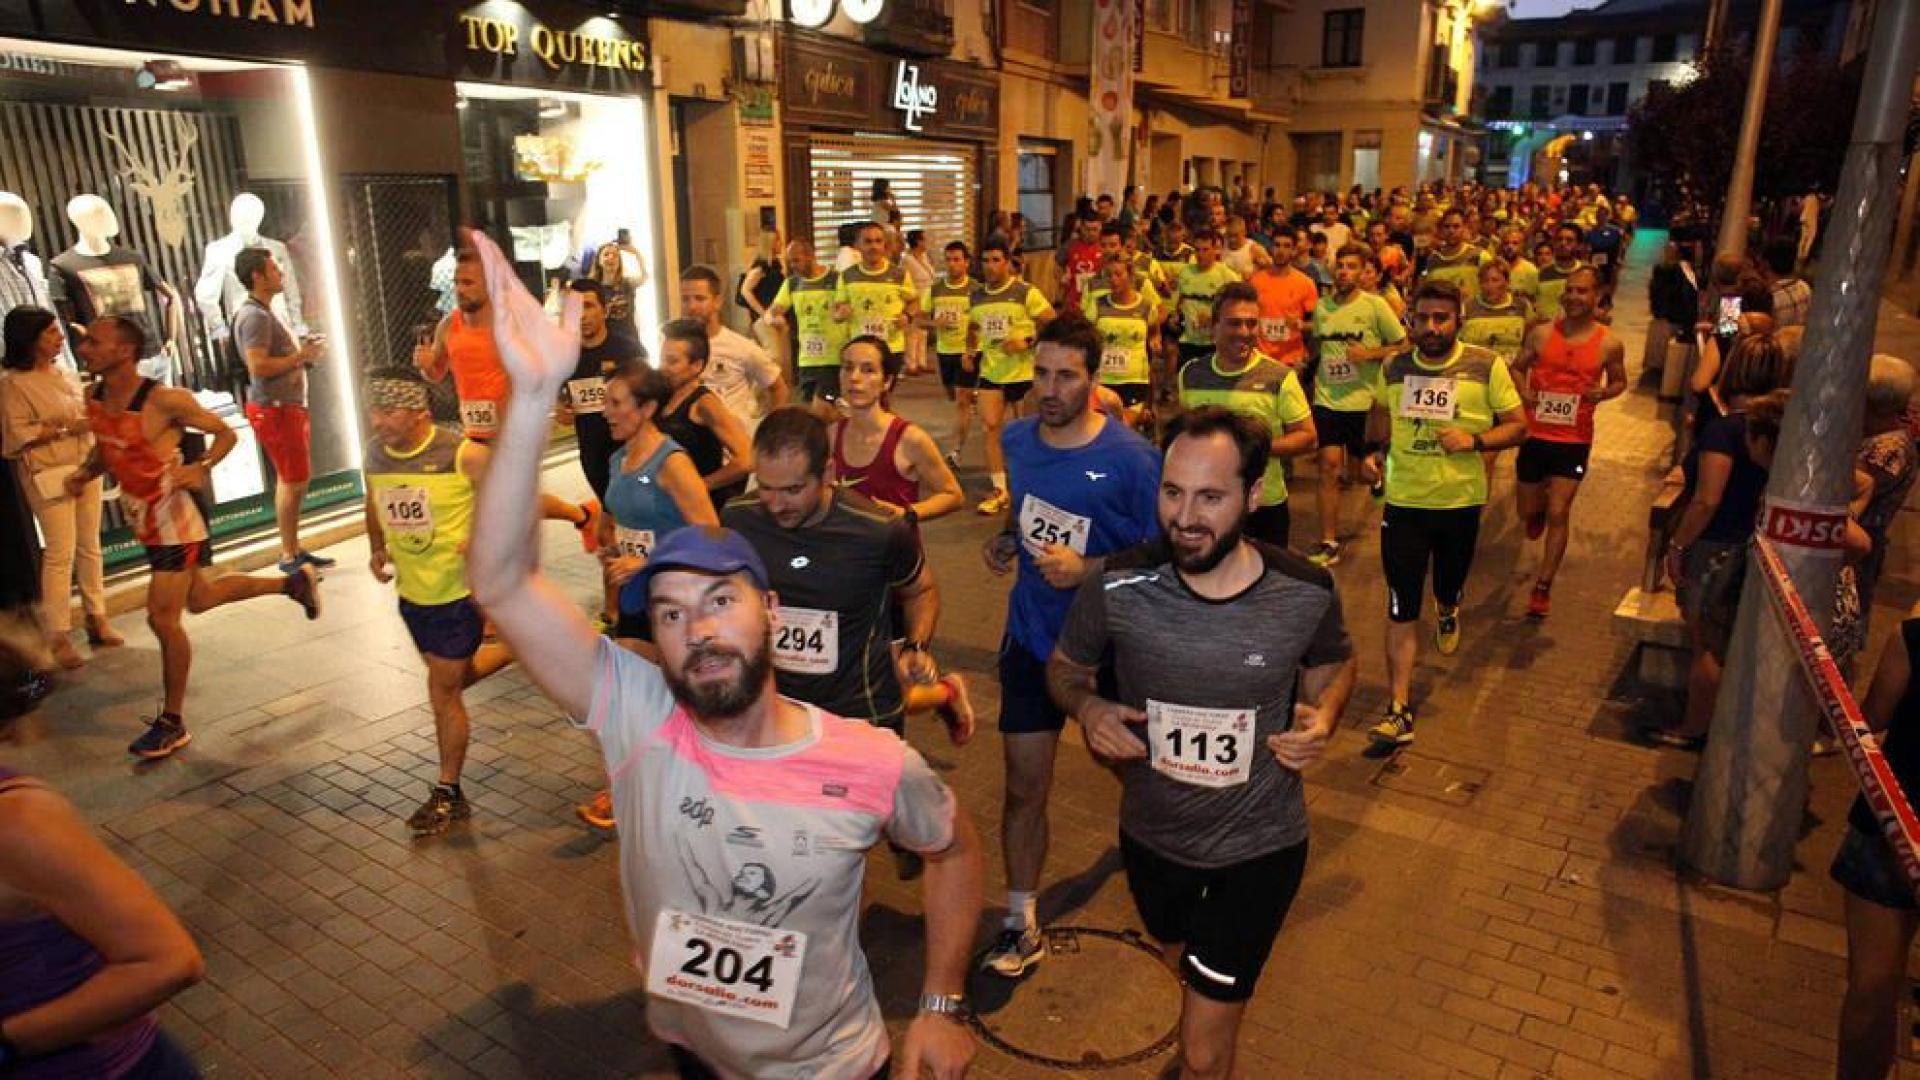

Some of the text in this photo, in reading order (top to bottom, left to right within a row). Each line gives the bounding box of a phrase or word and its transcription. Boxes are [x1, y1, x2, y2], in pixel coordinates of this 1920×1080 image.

[460, 15, 645, 71] TOP QUEENS
[1414, 389, 1448, 407] 136
[1543, 401, 1571, 415] 240
[388, 502, 423, 519] 108
[1030, 516, 1071, 547] 251
[776, 626, 824, 653] 294
[1166, 728, 1238, 765] 113
[680, 937, 774, 992] 204
